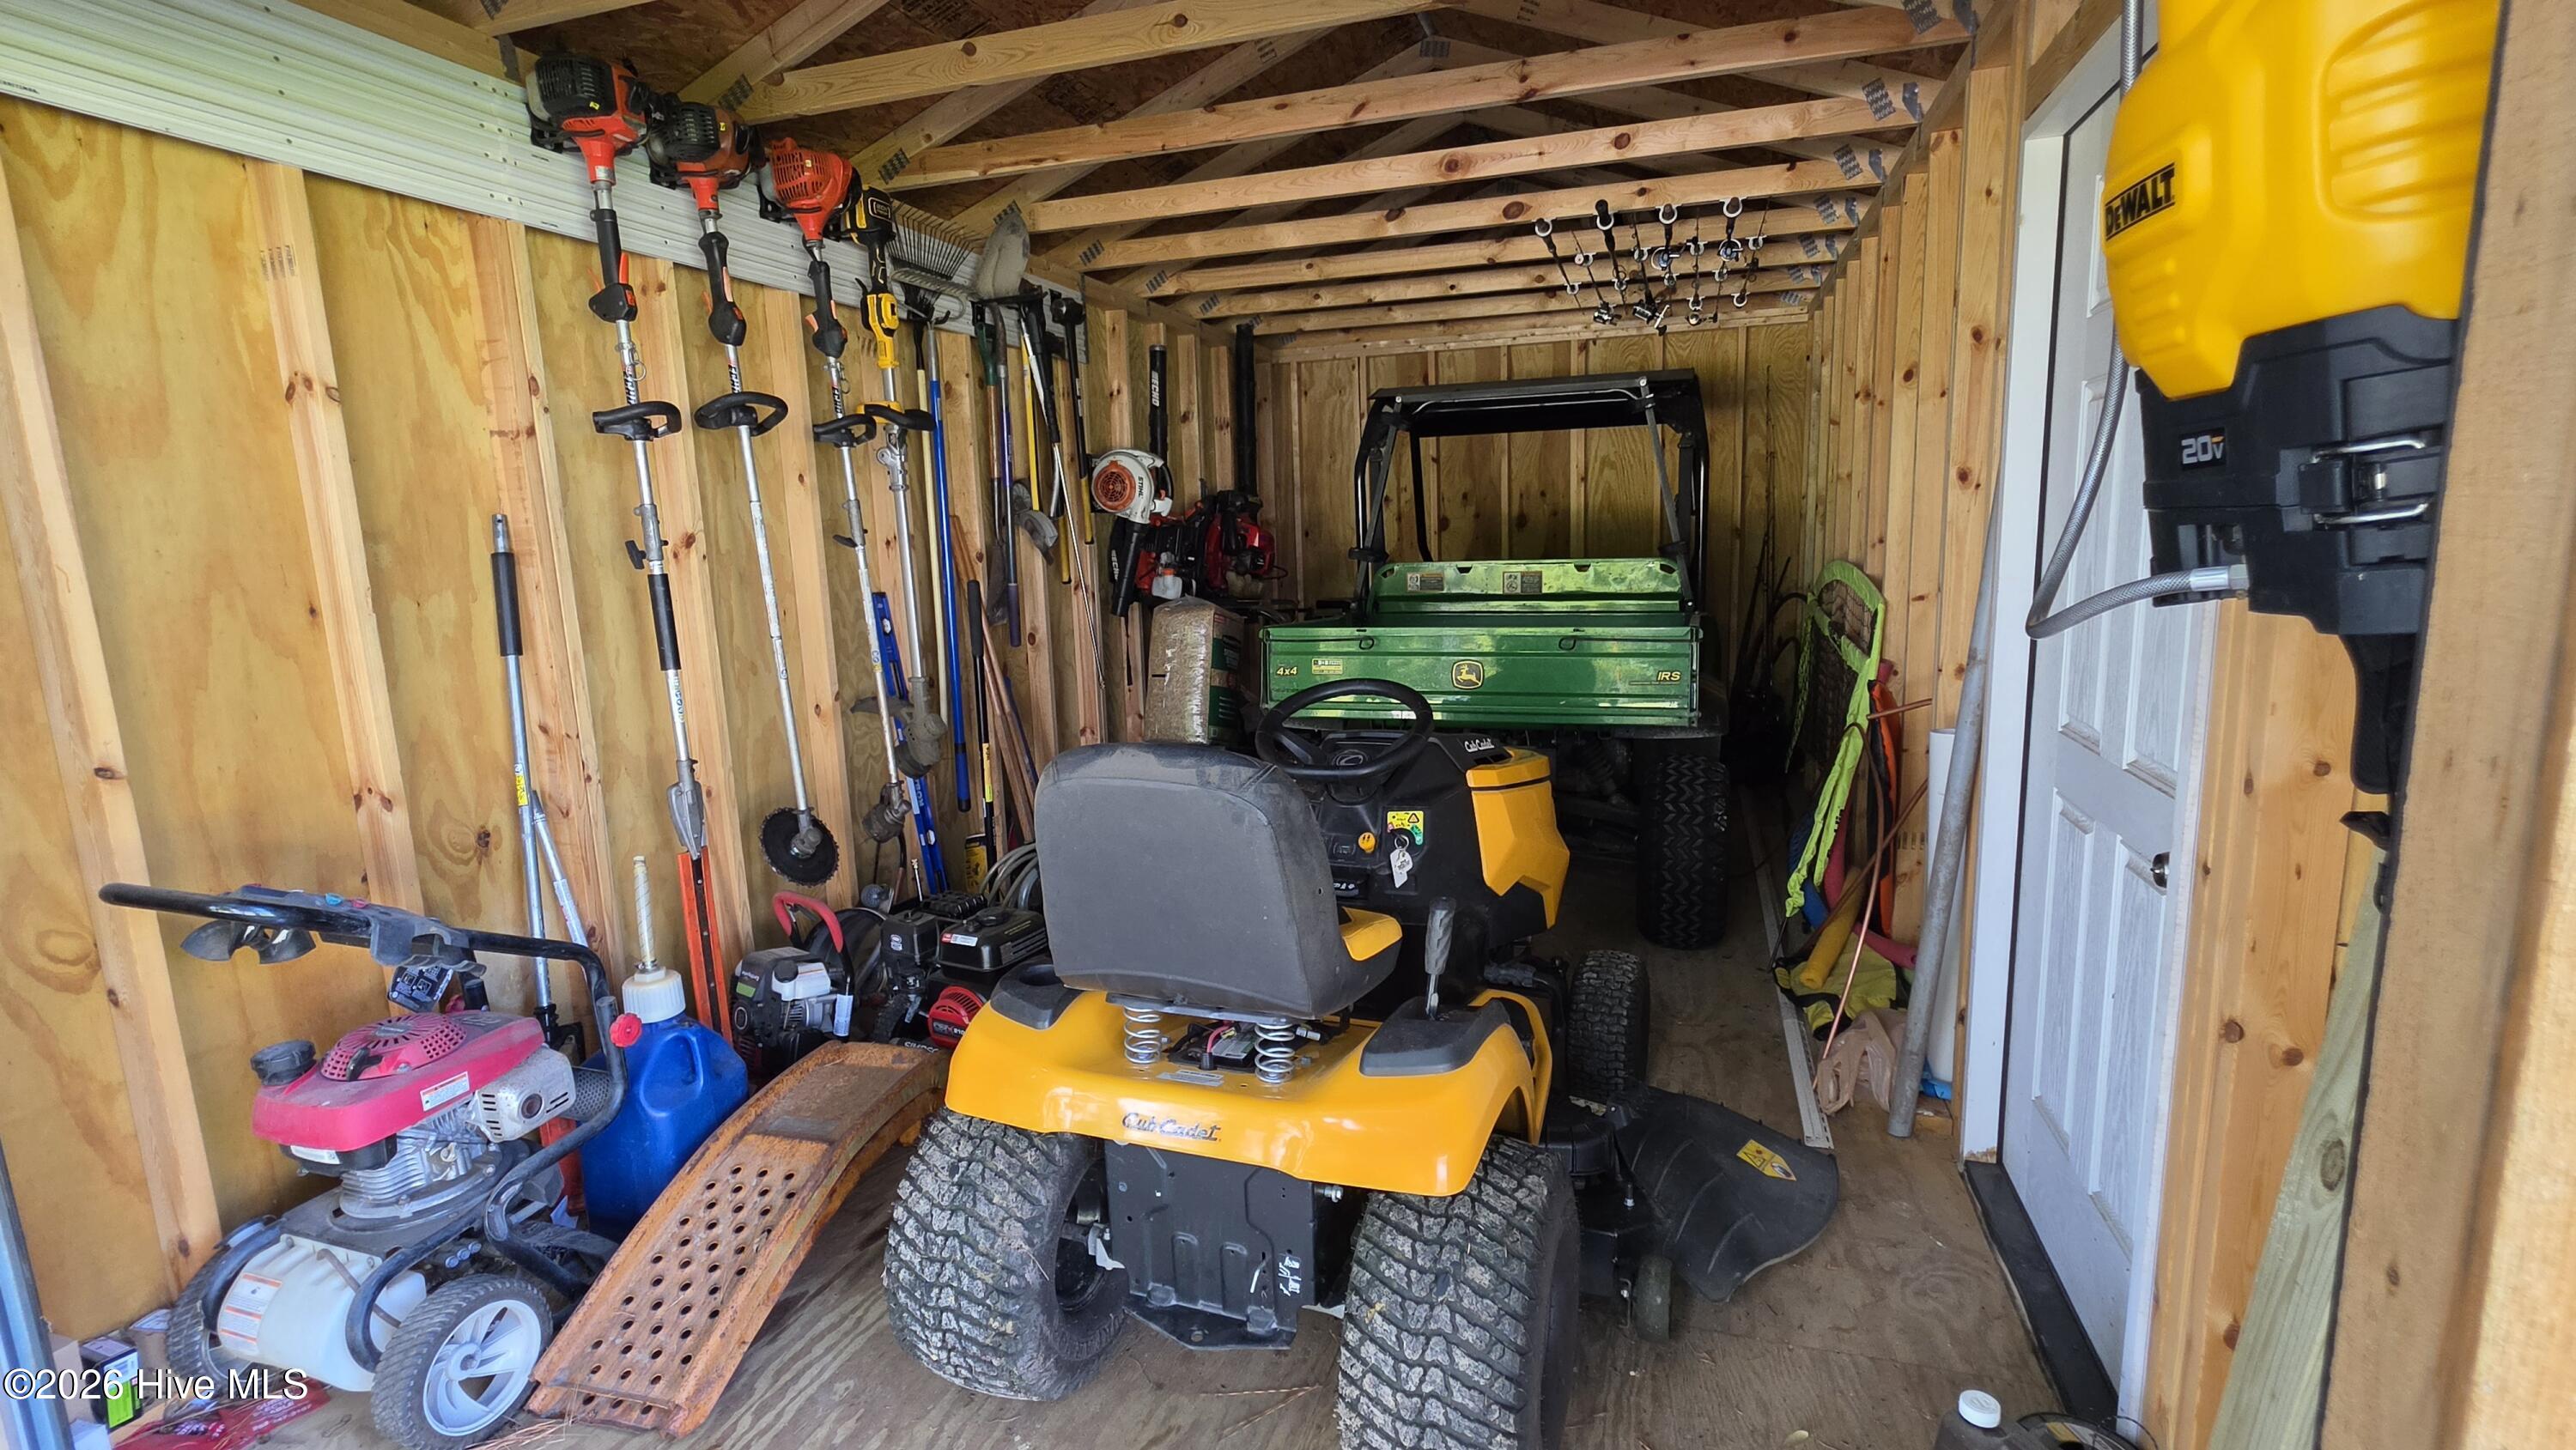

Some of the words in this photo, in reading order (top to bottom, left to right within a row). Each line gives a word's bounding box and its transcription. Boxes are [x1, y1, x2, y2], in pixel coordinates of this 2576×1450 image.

[1151, 378, 1160, 407] ECHO
[1276, 666, 1297, 676] 4x4
[1657, 671, 1681, 681] IRS
[1464, 740, 1478, 752] Cub
[1122, 1113, 1156, 1132] Cub
[1160, 1119, 1221, 1141] Cadet
